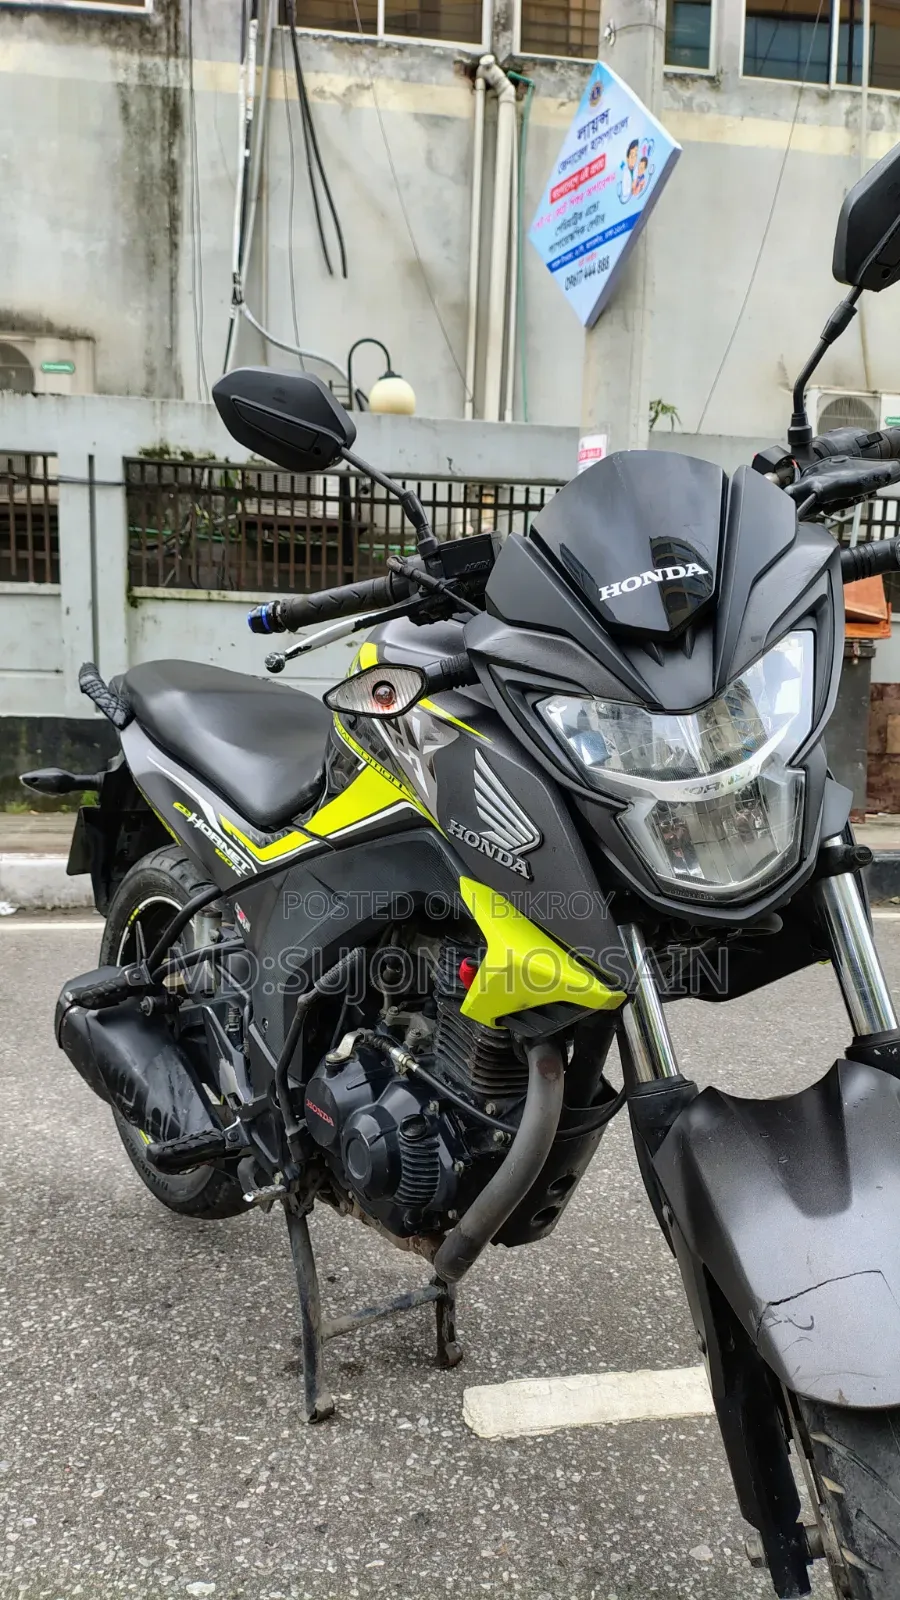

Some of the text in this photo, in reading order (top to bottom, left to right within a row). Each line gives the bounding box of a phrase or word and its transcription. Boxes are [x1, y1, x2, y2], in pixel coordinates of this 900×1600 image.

[599, 563, 708, 601] HONDA
[447, 818, 530, 880] HONDA
[306, 1098, 335, 1127] HONDA
